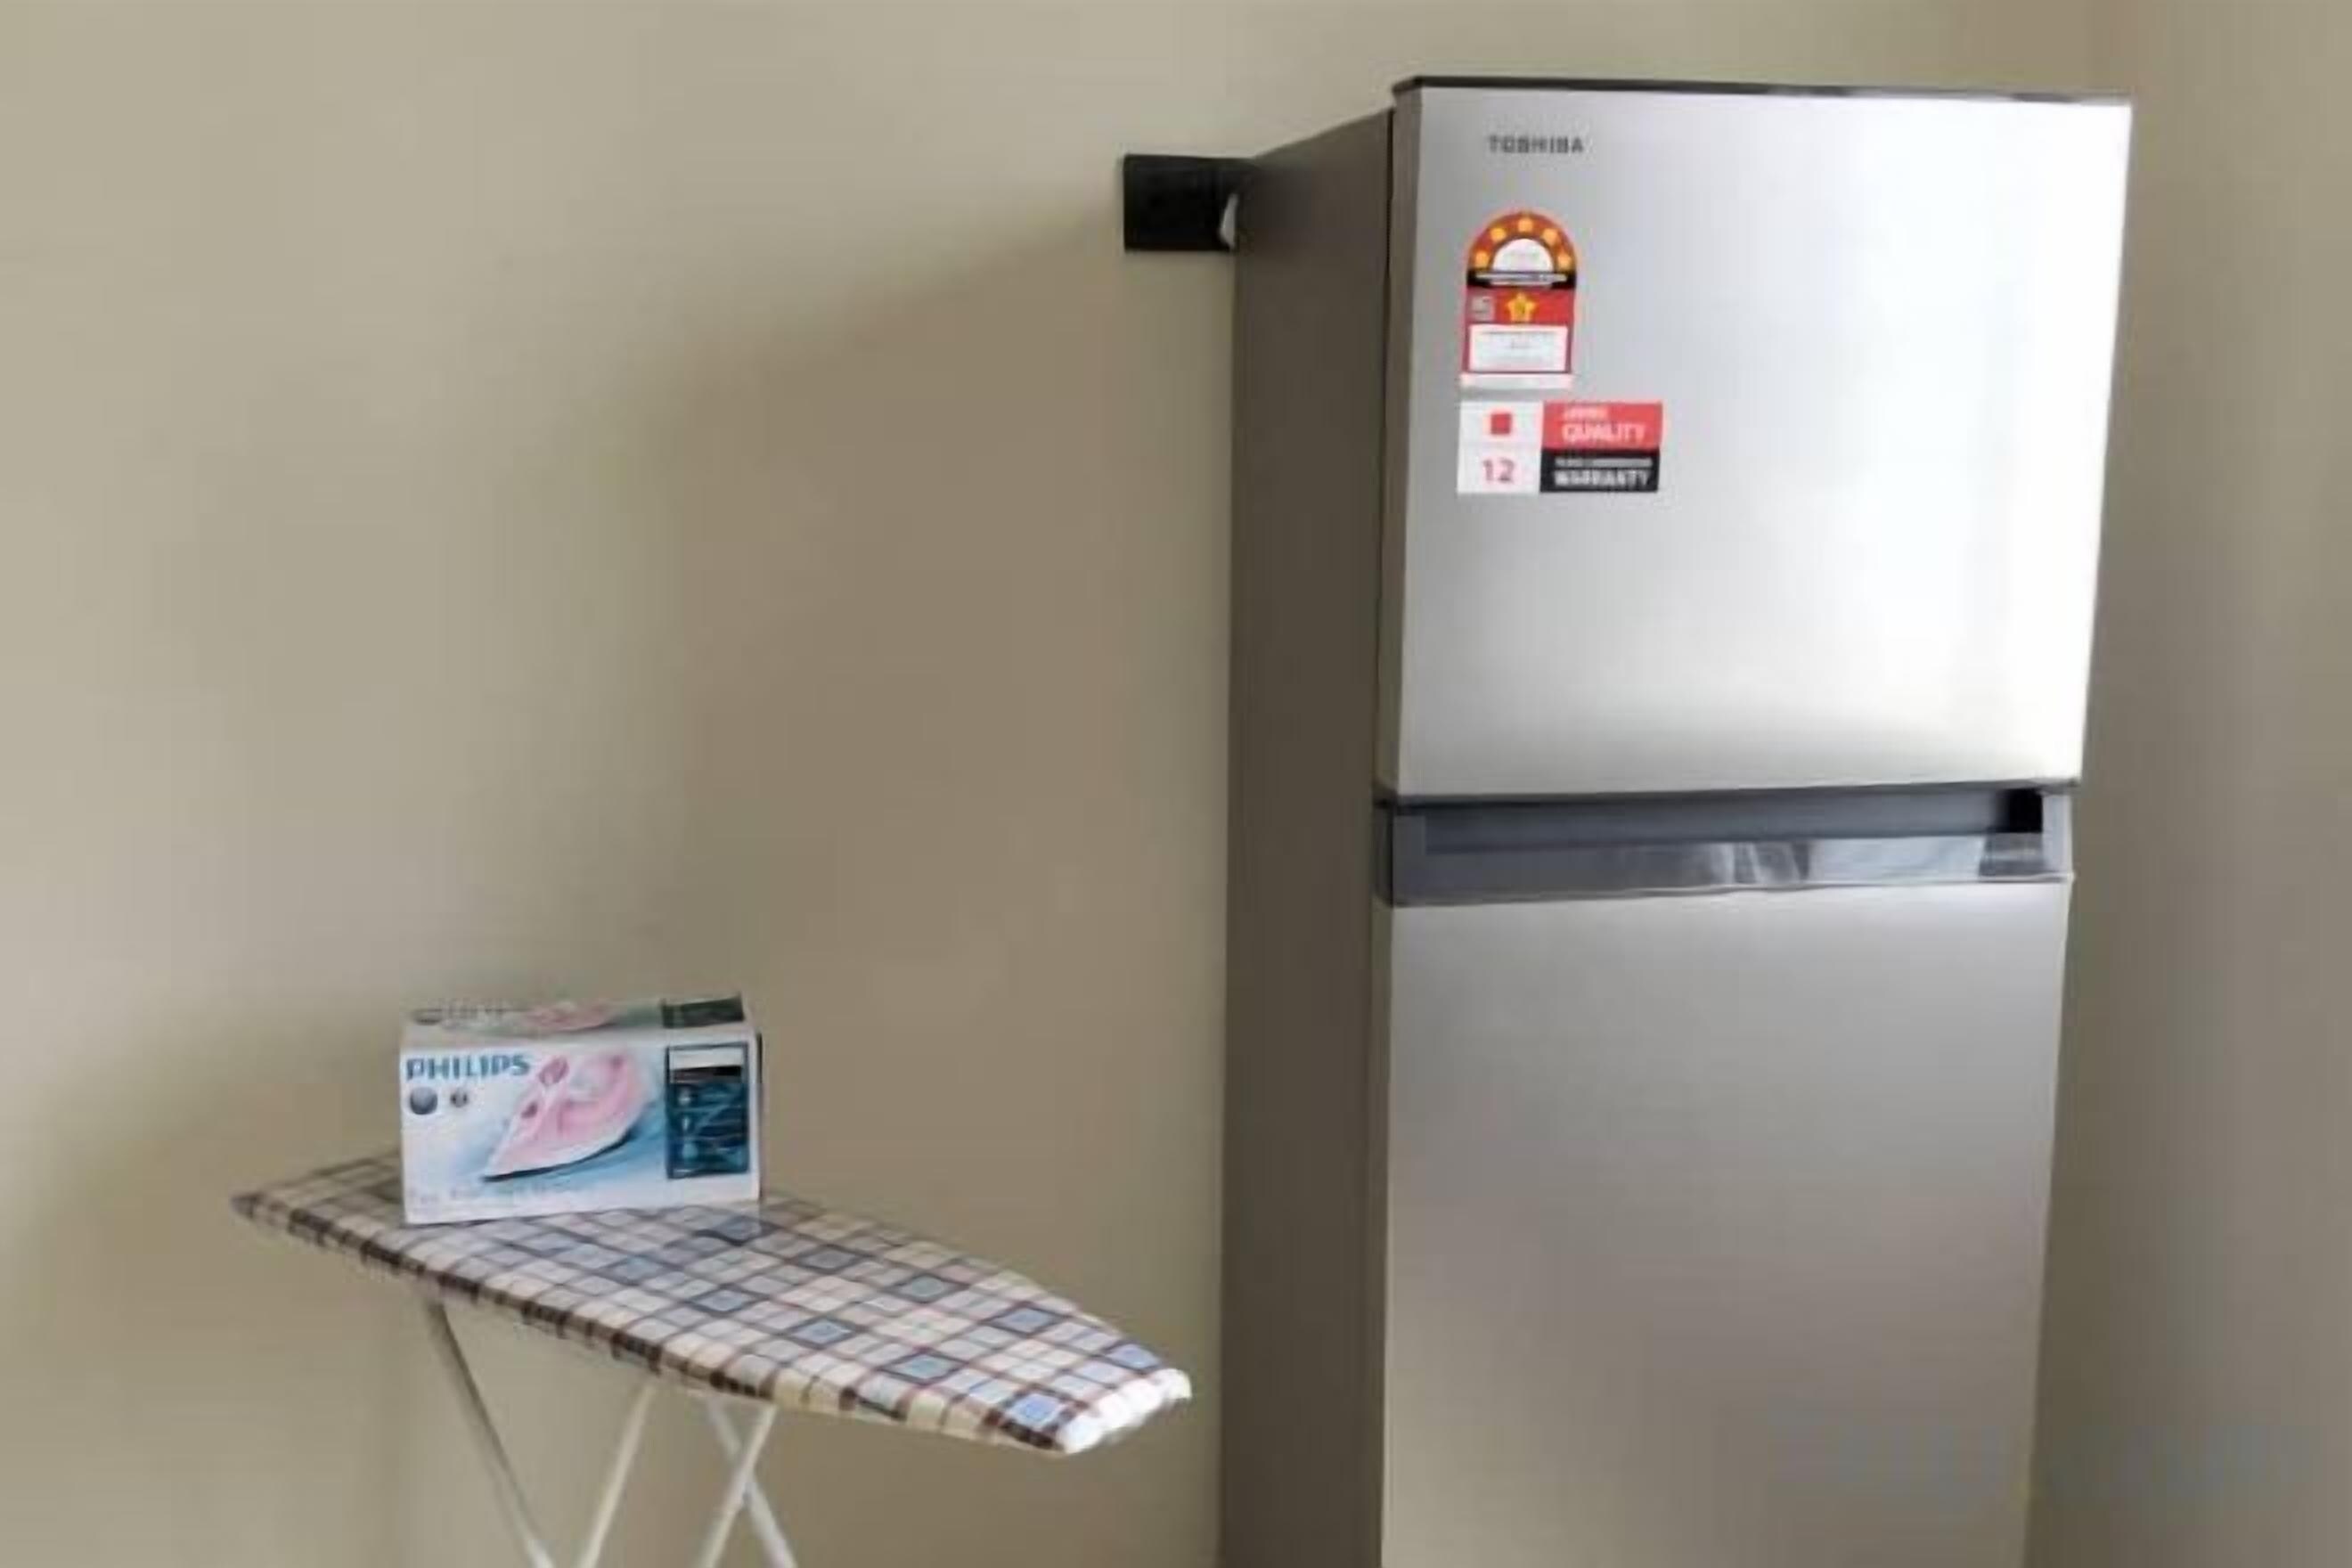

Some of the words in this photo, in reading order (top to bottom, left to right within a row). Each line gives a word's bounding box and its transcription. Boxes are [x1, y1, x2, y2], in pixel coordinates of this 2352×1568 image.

[1488, 135, 1583, 153] TOSHIBA
[1562, 421, 1647, 444] QUALITY
[1483, 458, 1515, 482] 12
[1555, 469, 1649, 487] WARRANTY
[406, 1055, 529, 1081] PHILIPS
